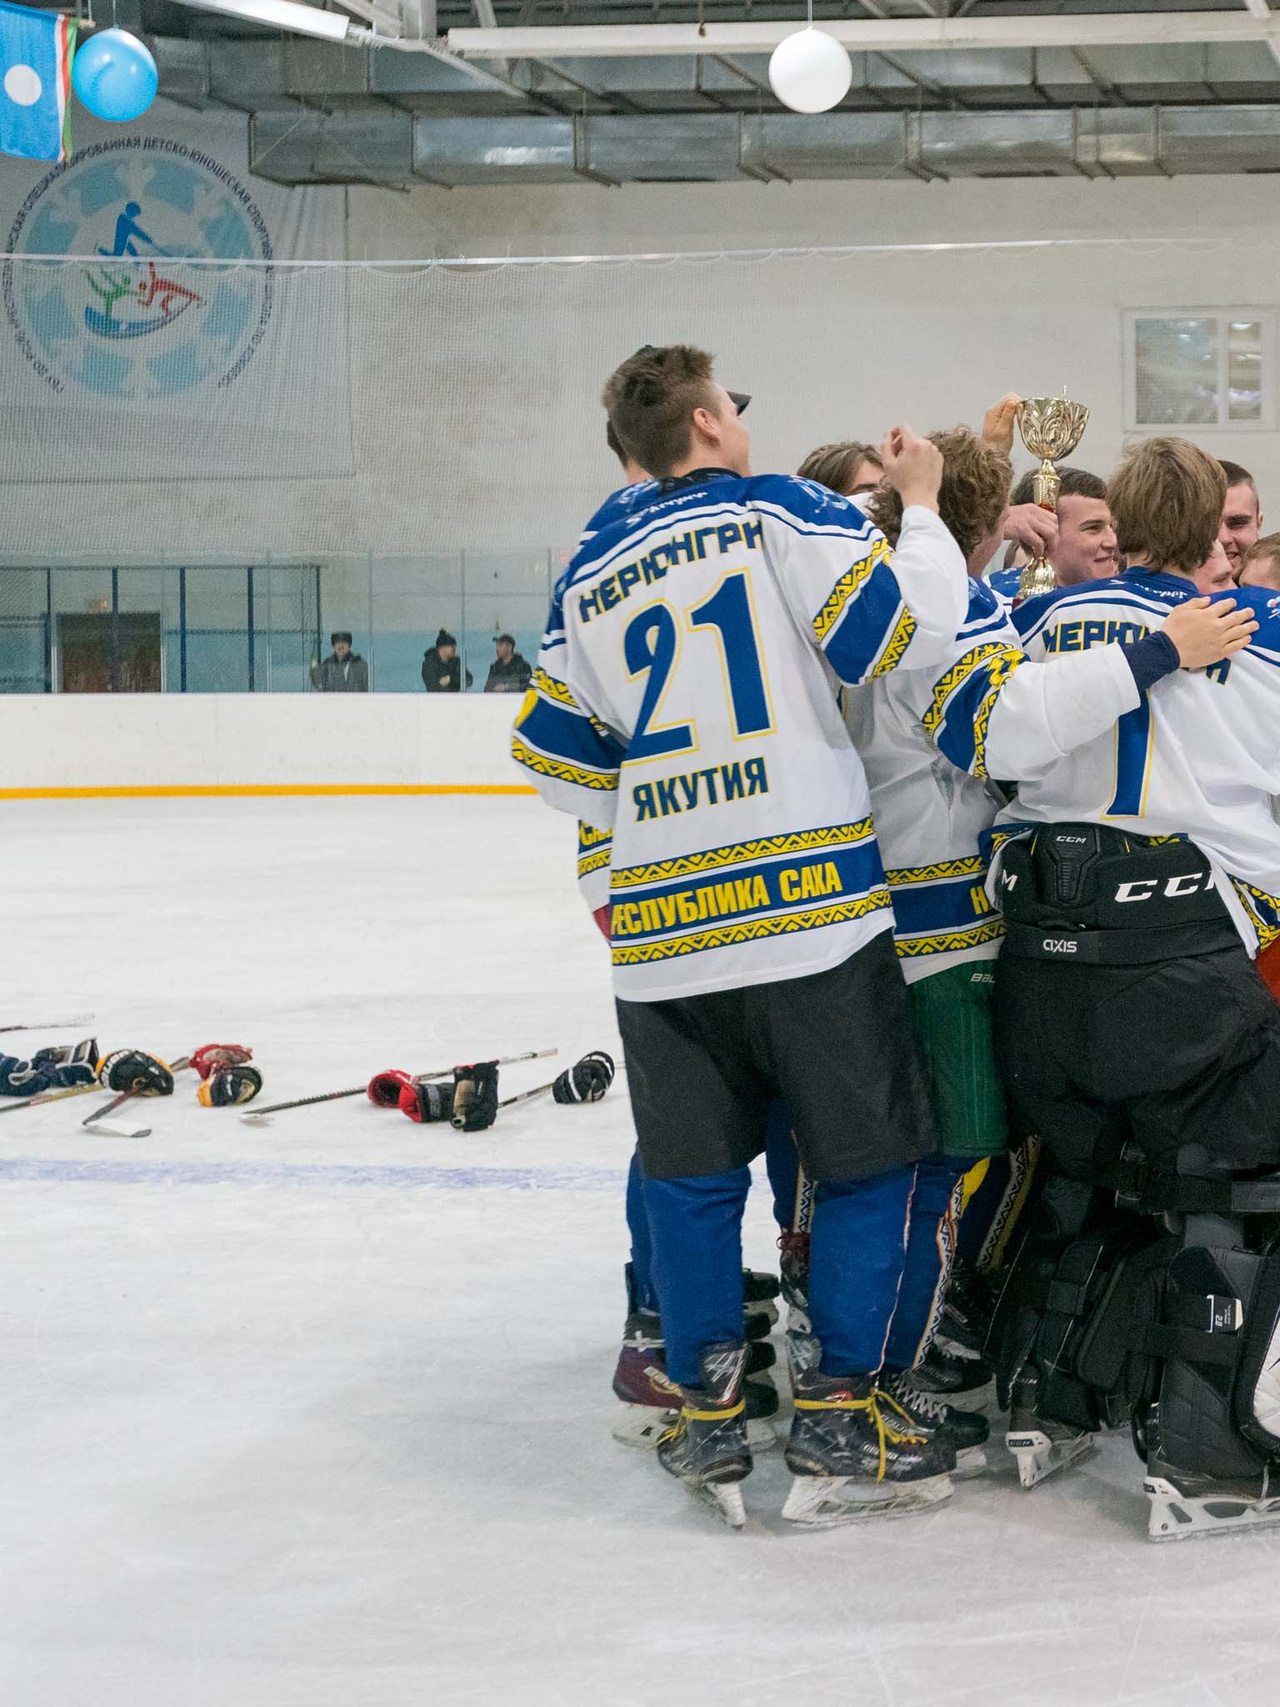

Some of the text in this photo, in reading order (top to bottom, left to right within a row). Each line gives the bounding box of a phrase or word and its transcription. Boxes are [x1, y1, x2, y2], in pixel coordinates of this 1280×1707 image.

[621, 567, 778, 767] 21
[632, 756, 770, 823] ЯКУТИЯ
[1056, 834, 1087, 845] CCM
[778, 860, 844, 902] САХА
[970, 972, 996, 984] BAU
